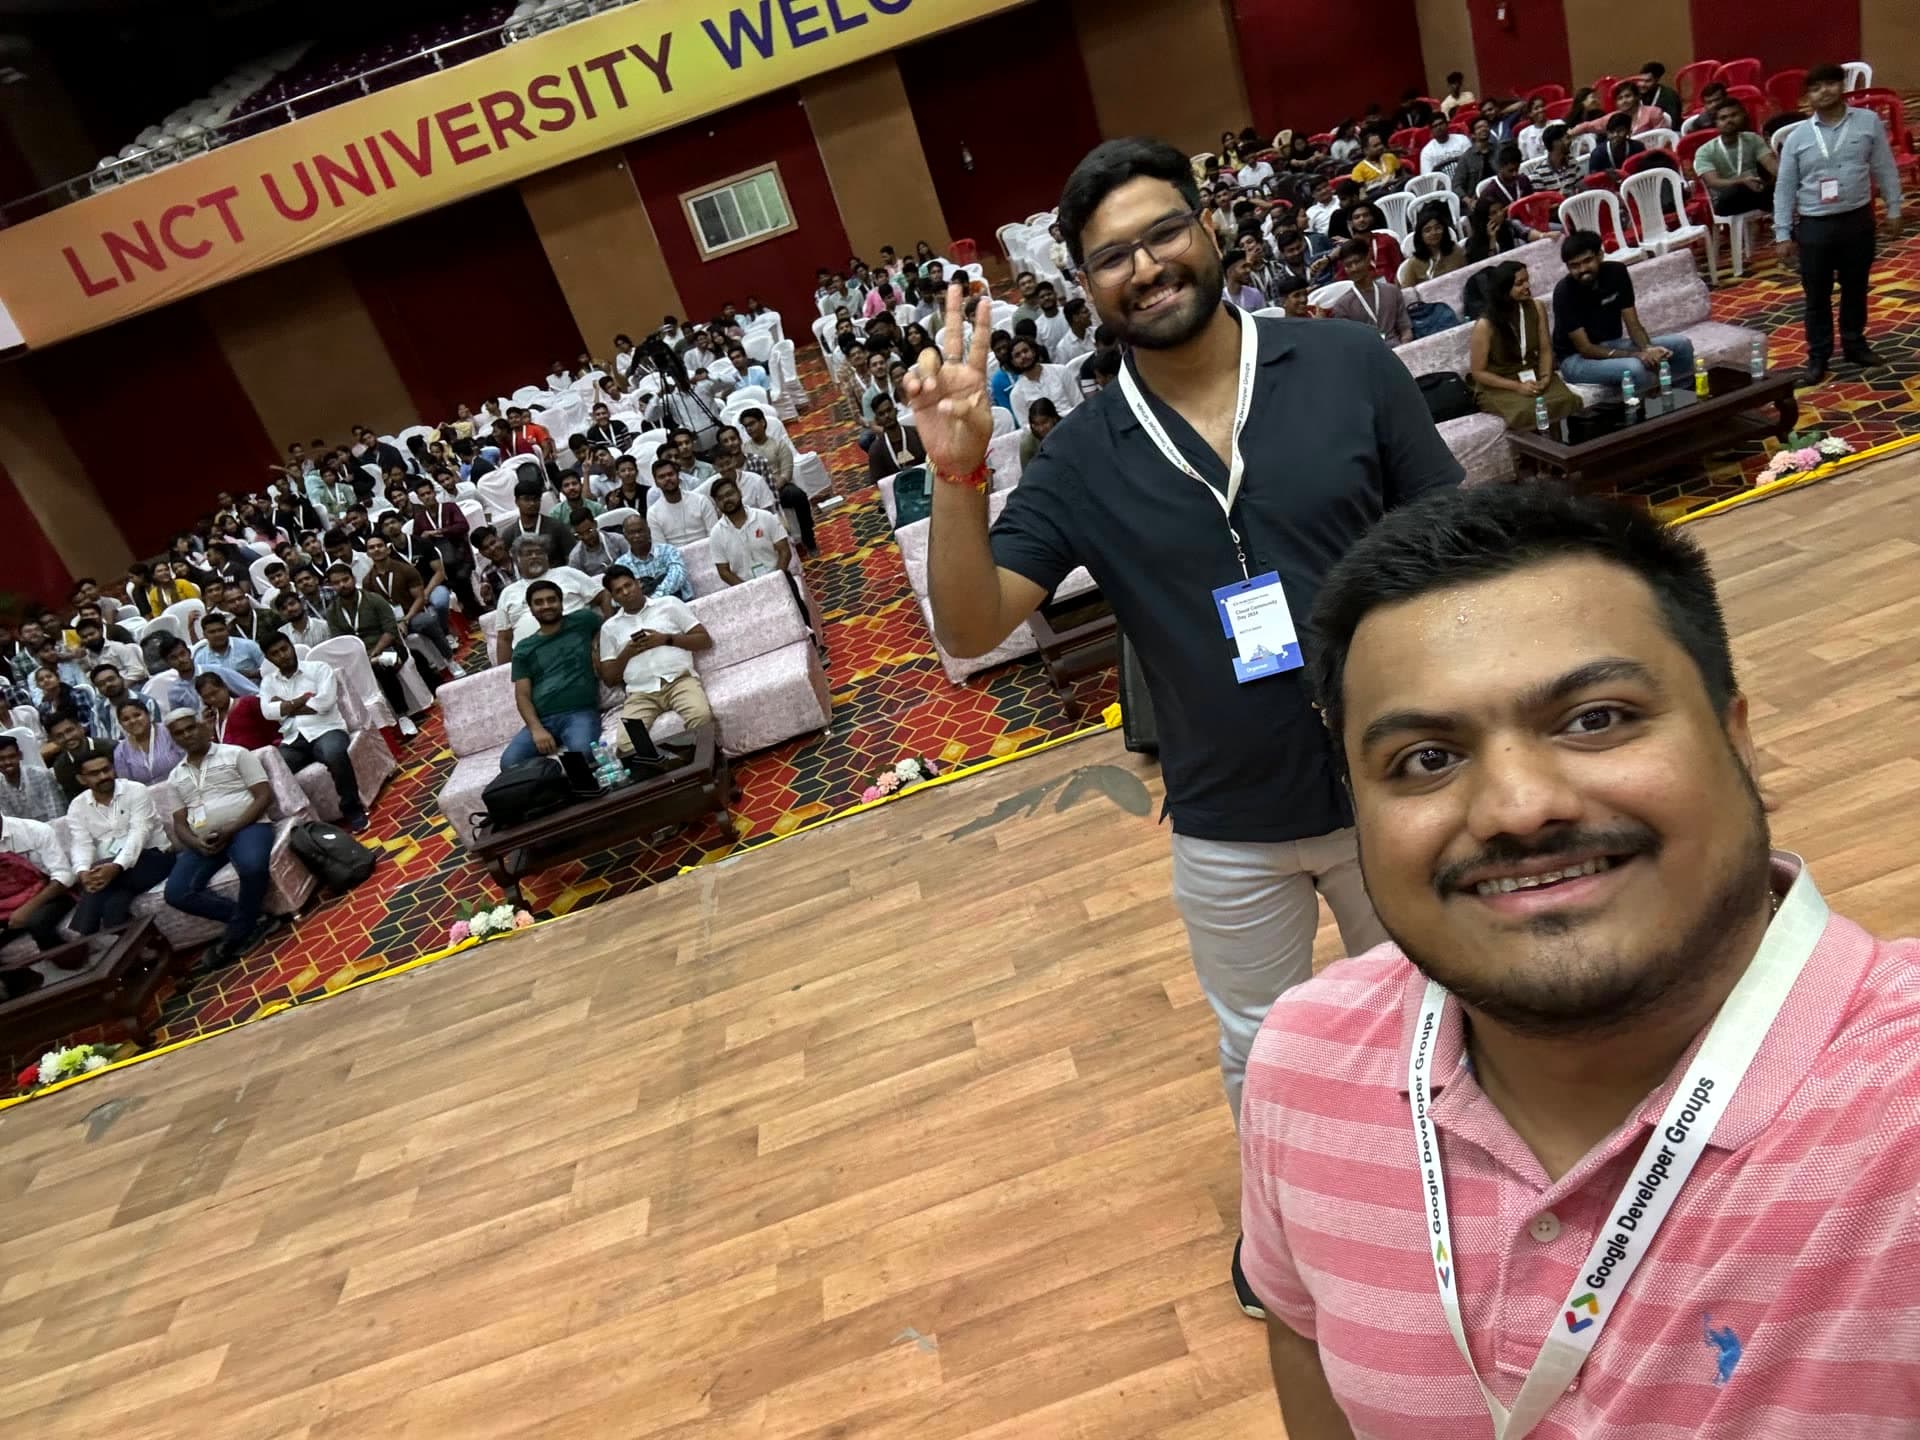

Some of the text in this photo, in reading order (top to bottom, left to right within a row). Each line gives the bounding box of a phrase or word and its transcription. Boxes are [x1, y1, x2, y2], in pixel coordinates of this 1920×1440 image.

[61, 186, 245, 299] LNCT
[259, 32, 673, 222] UNIVERSITY
[1414, 1012, 1441, 1235] Google Developer Groups
[1586, 1076, 1715, 1289] Google Developer Groups
